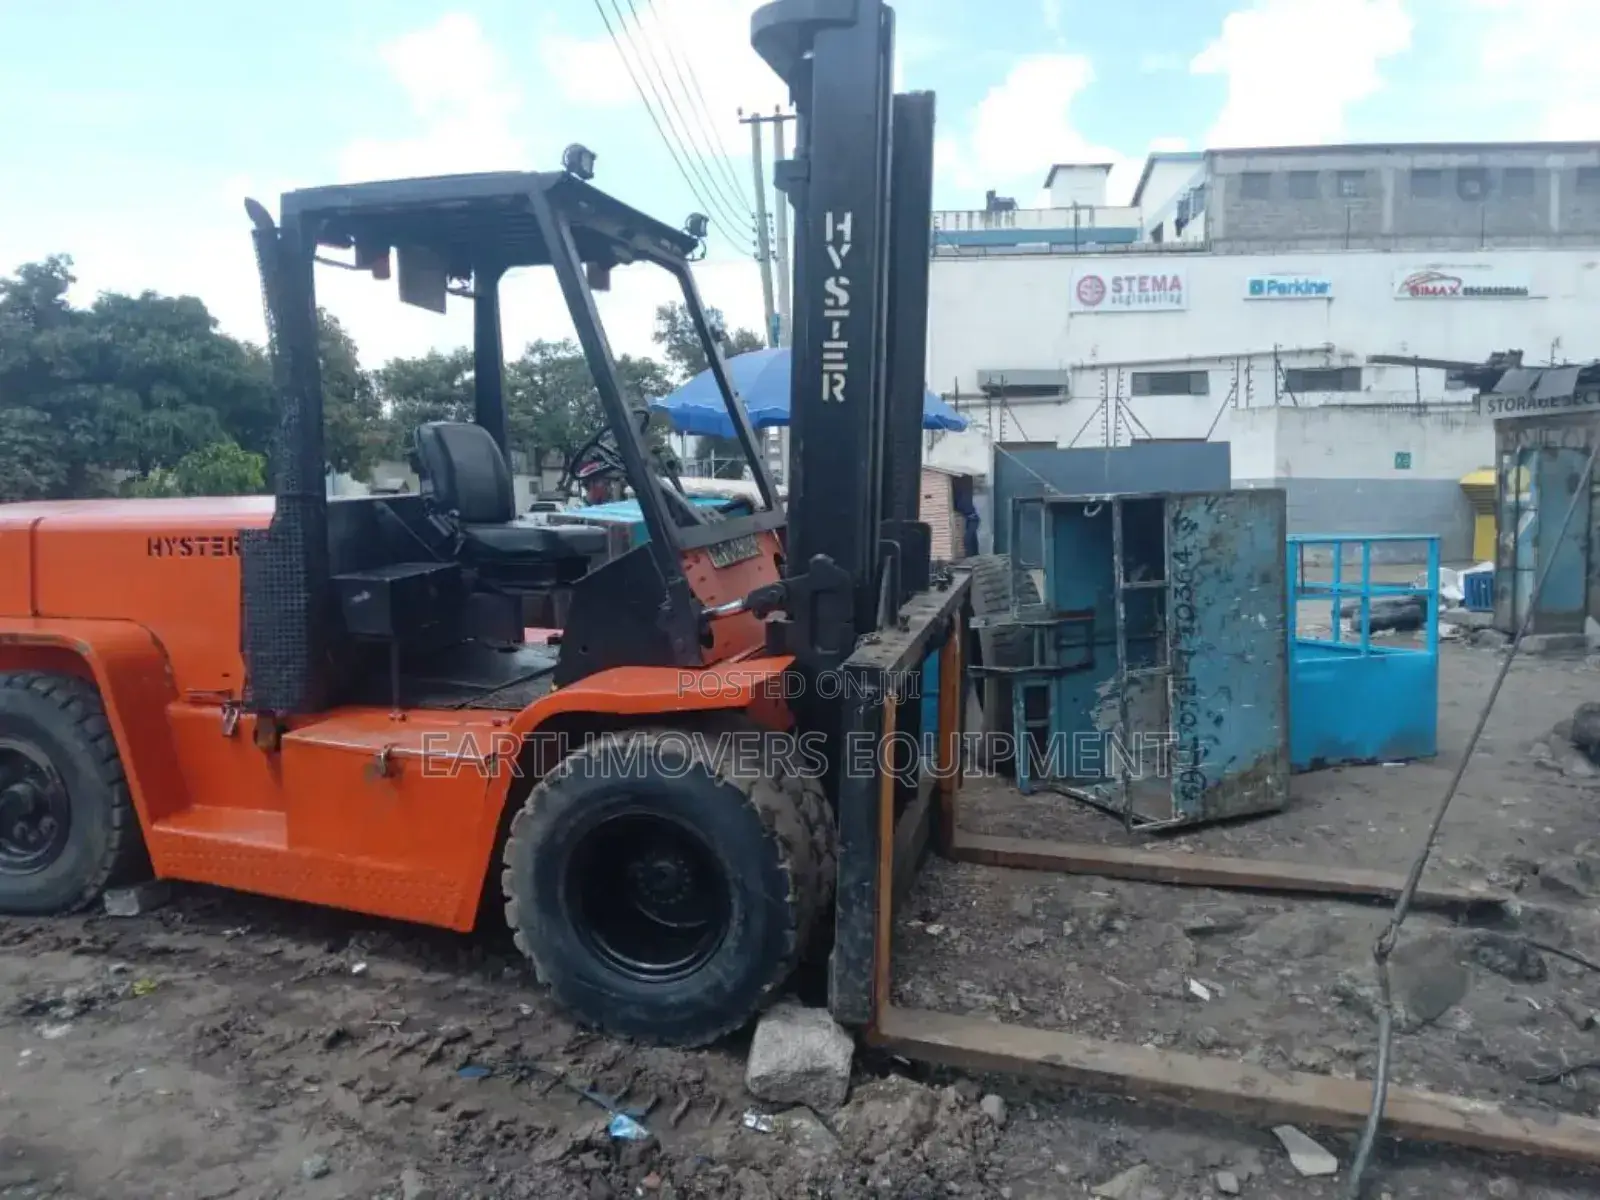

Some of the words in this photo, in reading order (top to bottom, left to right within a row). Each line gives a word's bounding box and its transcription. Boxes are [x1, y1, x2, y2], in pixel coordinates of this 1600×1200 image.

[1111, 275, 1182, 293] STEMA
[823, 211, 852, 402] HYSTER
[147, 536, 240, 557] HYSTER
